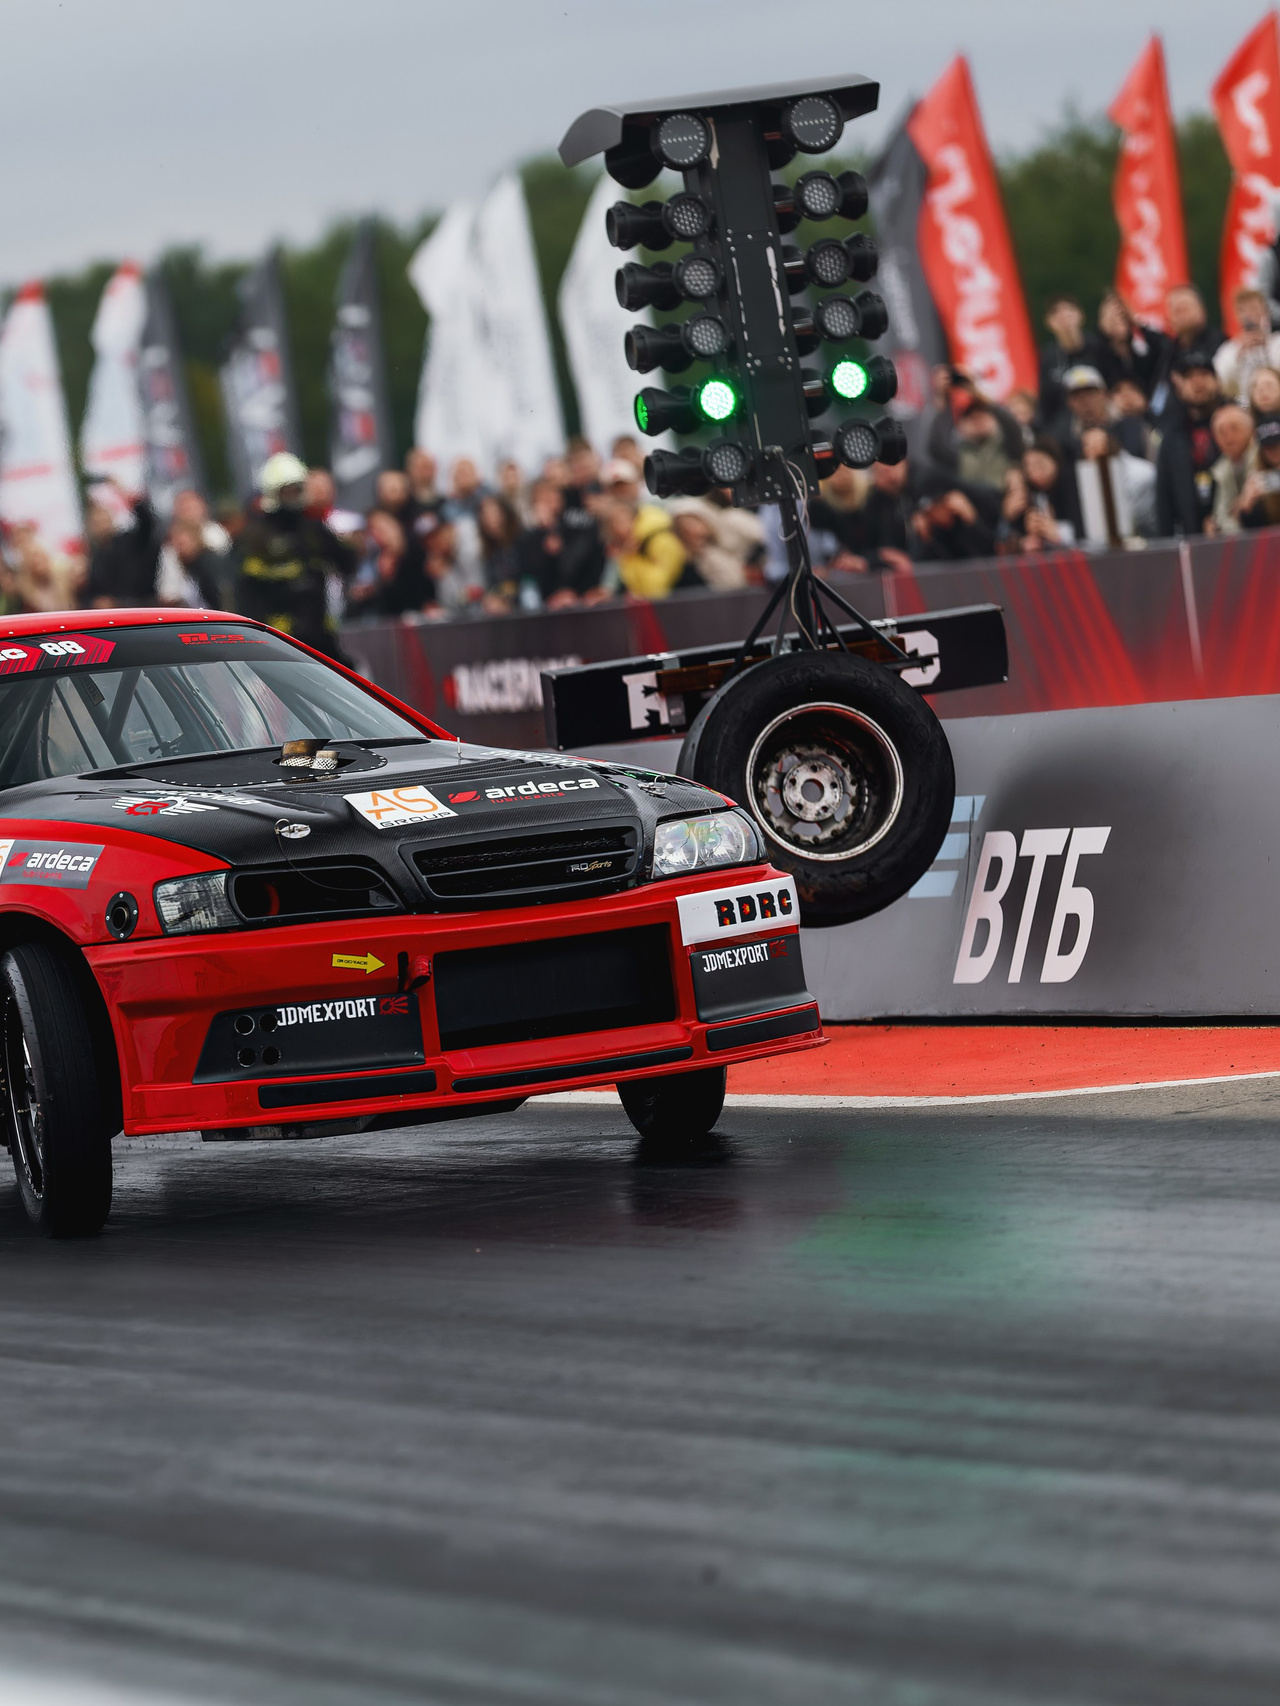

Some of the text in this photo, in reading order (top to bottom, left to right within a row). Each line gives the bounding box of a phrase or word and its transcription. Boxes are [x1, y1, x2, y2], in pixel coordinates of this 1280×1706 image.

[38, 640, 86, 656] 88
[485, 777, 601, 800] ardeca
[490, 790, 566, 805] lubricants
[379, 810, 451, 829] GROUP
[26, 849, 94, 872] ardeca
[22, 869, 63, 880] lubricants
[714, 888, 793, 928] RDRC
[953, 826, 1112, 984] ВТБ
[701, 943, 769, 973] JDMEXPORT
[276, 997, 377, 1027] JDMEXPORT
